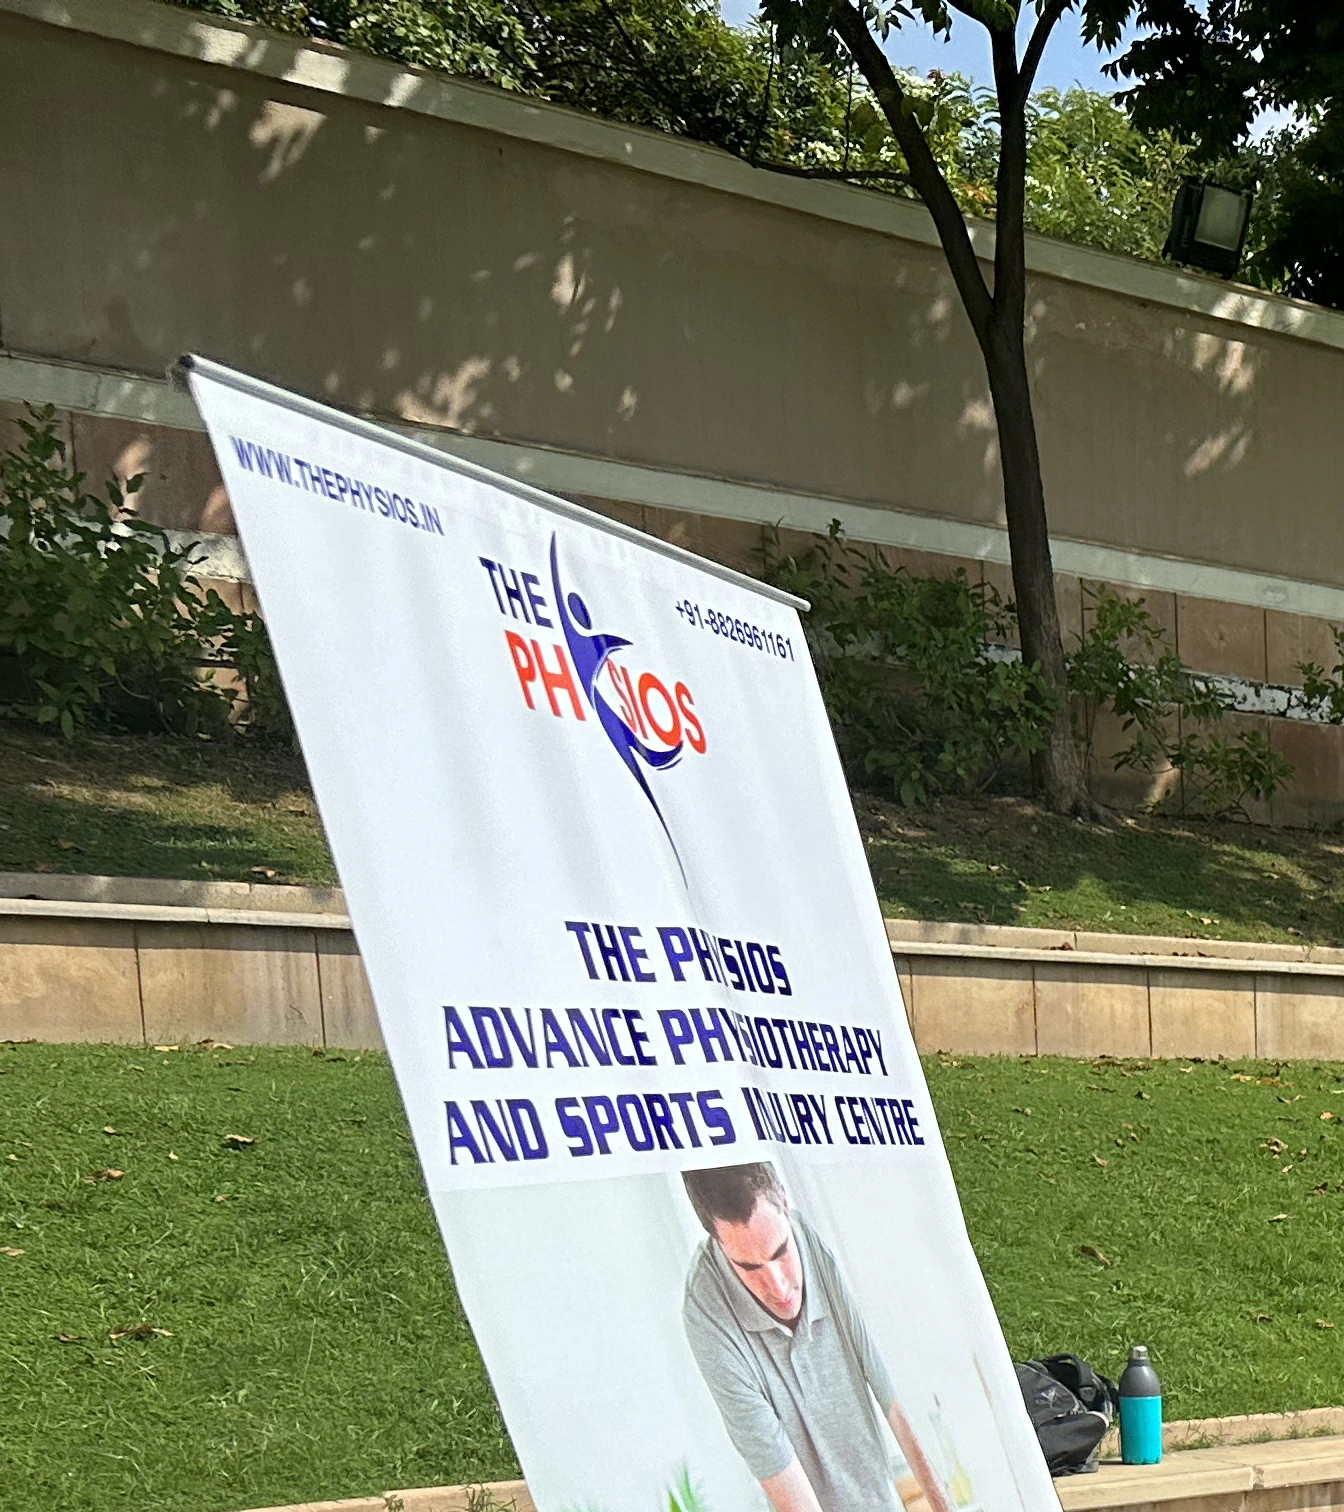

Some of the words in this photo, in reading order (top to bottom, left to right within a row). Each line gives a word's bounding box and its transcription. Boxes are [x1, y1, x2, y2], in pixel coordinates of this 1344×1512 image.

[230, 436, 445, 537] WWW.THEPHYSIOS.IN
[477, 556, 553, 630] THE
[675, 600, 795, 662] +91-8826961161
[564, 920, 657, 983] THE
[656, 926, 792, 996] PHYSIOS
[442, 1005, 657, 1070] ADVANCE
[657, 1007, 889, 1077] PHYSIOTHERAPY
[443, 1098, 549, 1166] AND
[555, 1090, 737, 1158] SPORTS
[741, 1086, 834, 1146] INJURY
[836, 1096, 925, 1147] CENTRE
